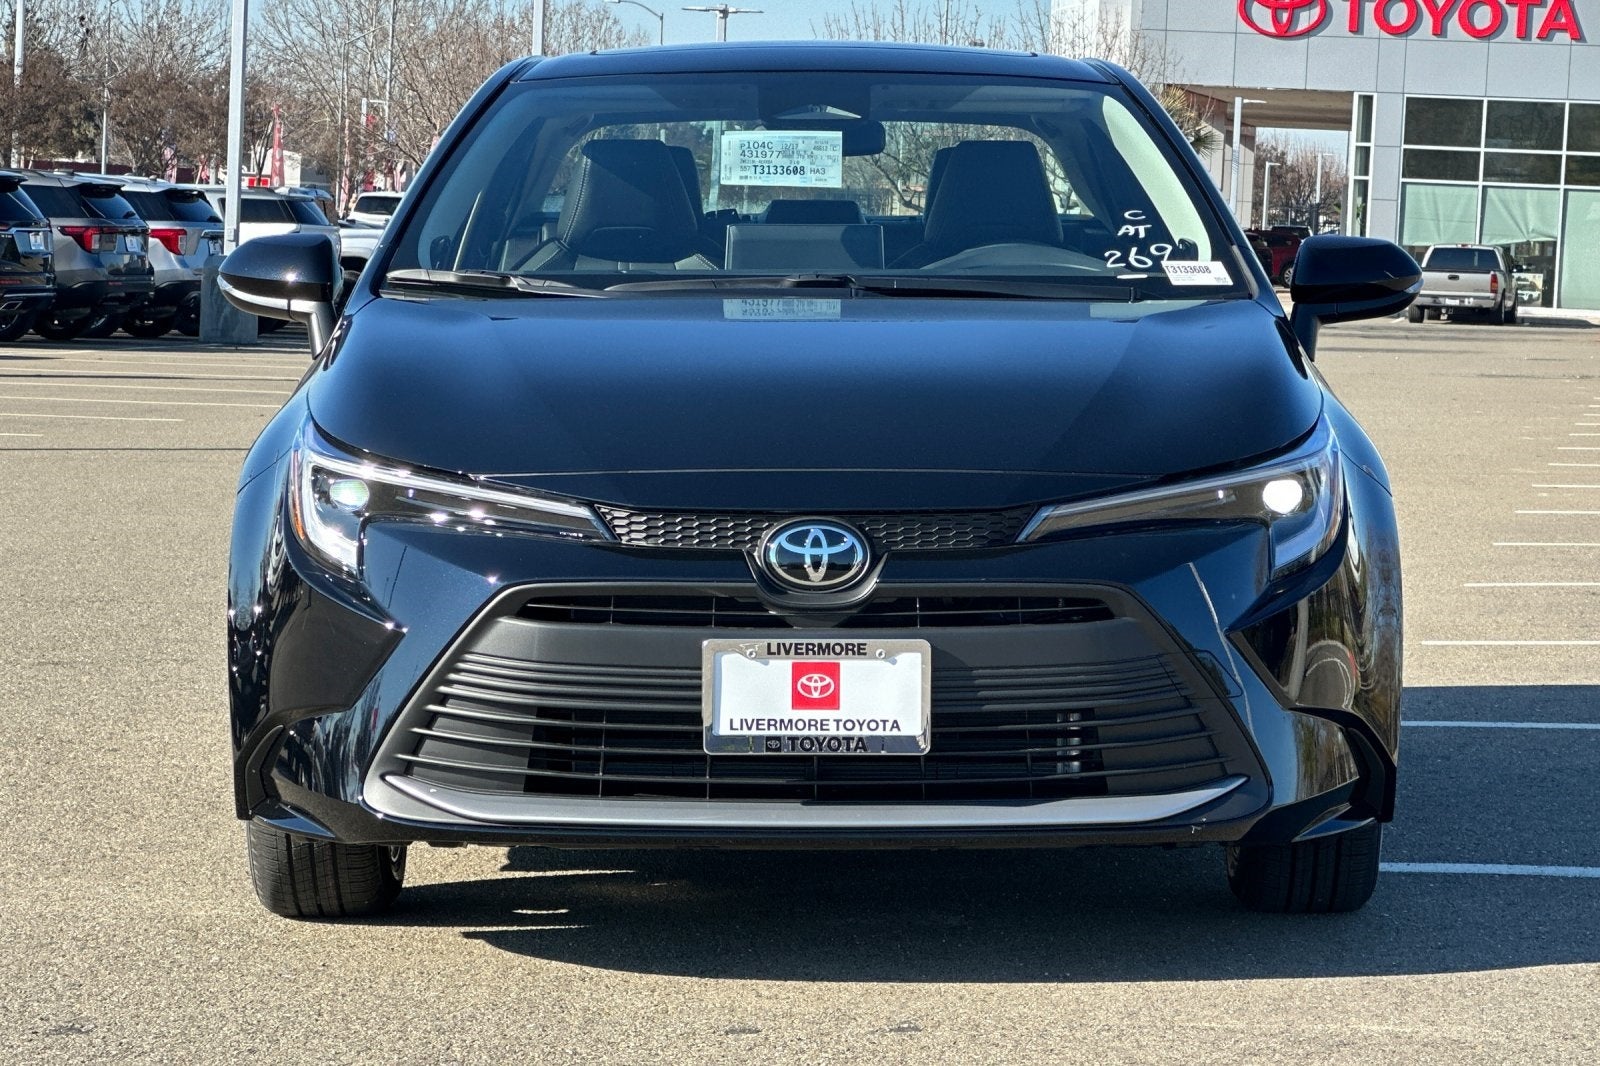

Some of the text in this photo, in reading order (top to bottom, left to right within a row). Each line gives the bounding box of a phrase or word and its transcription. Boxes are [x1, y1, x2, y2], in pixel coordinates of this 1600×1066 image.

[1342, 0, 1582, 40] TOYOTA
[740, 150, 782, 159] 431977
[752, 164, 805, 175] T3133608
[1104, 243, 1173, 269] 269
[1165, 265, 1212, 274] T3133608
[766, 642, 868, 656] LIVERMORE
[729, 718, 901, 732] LIVERMORE TOYOTA
[787, 737, 868, 752] TOYOTA
